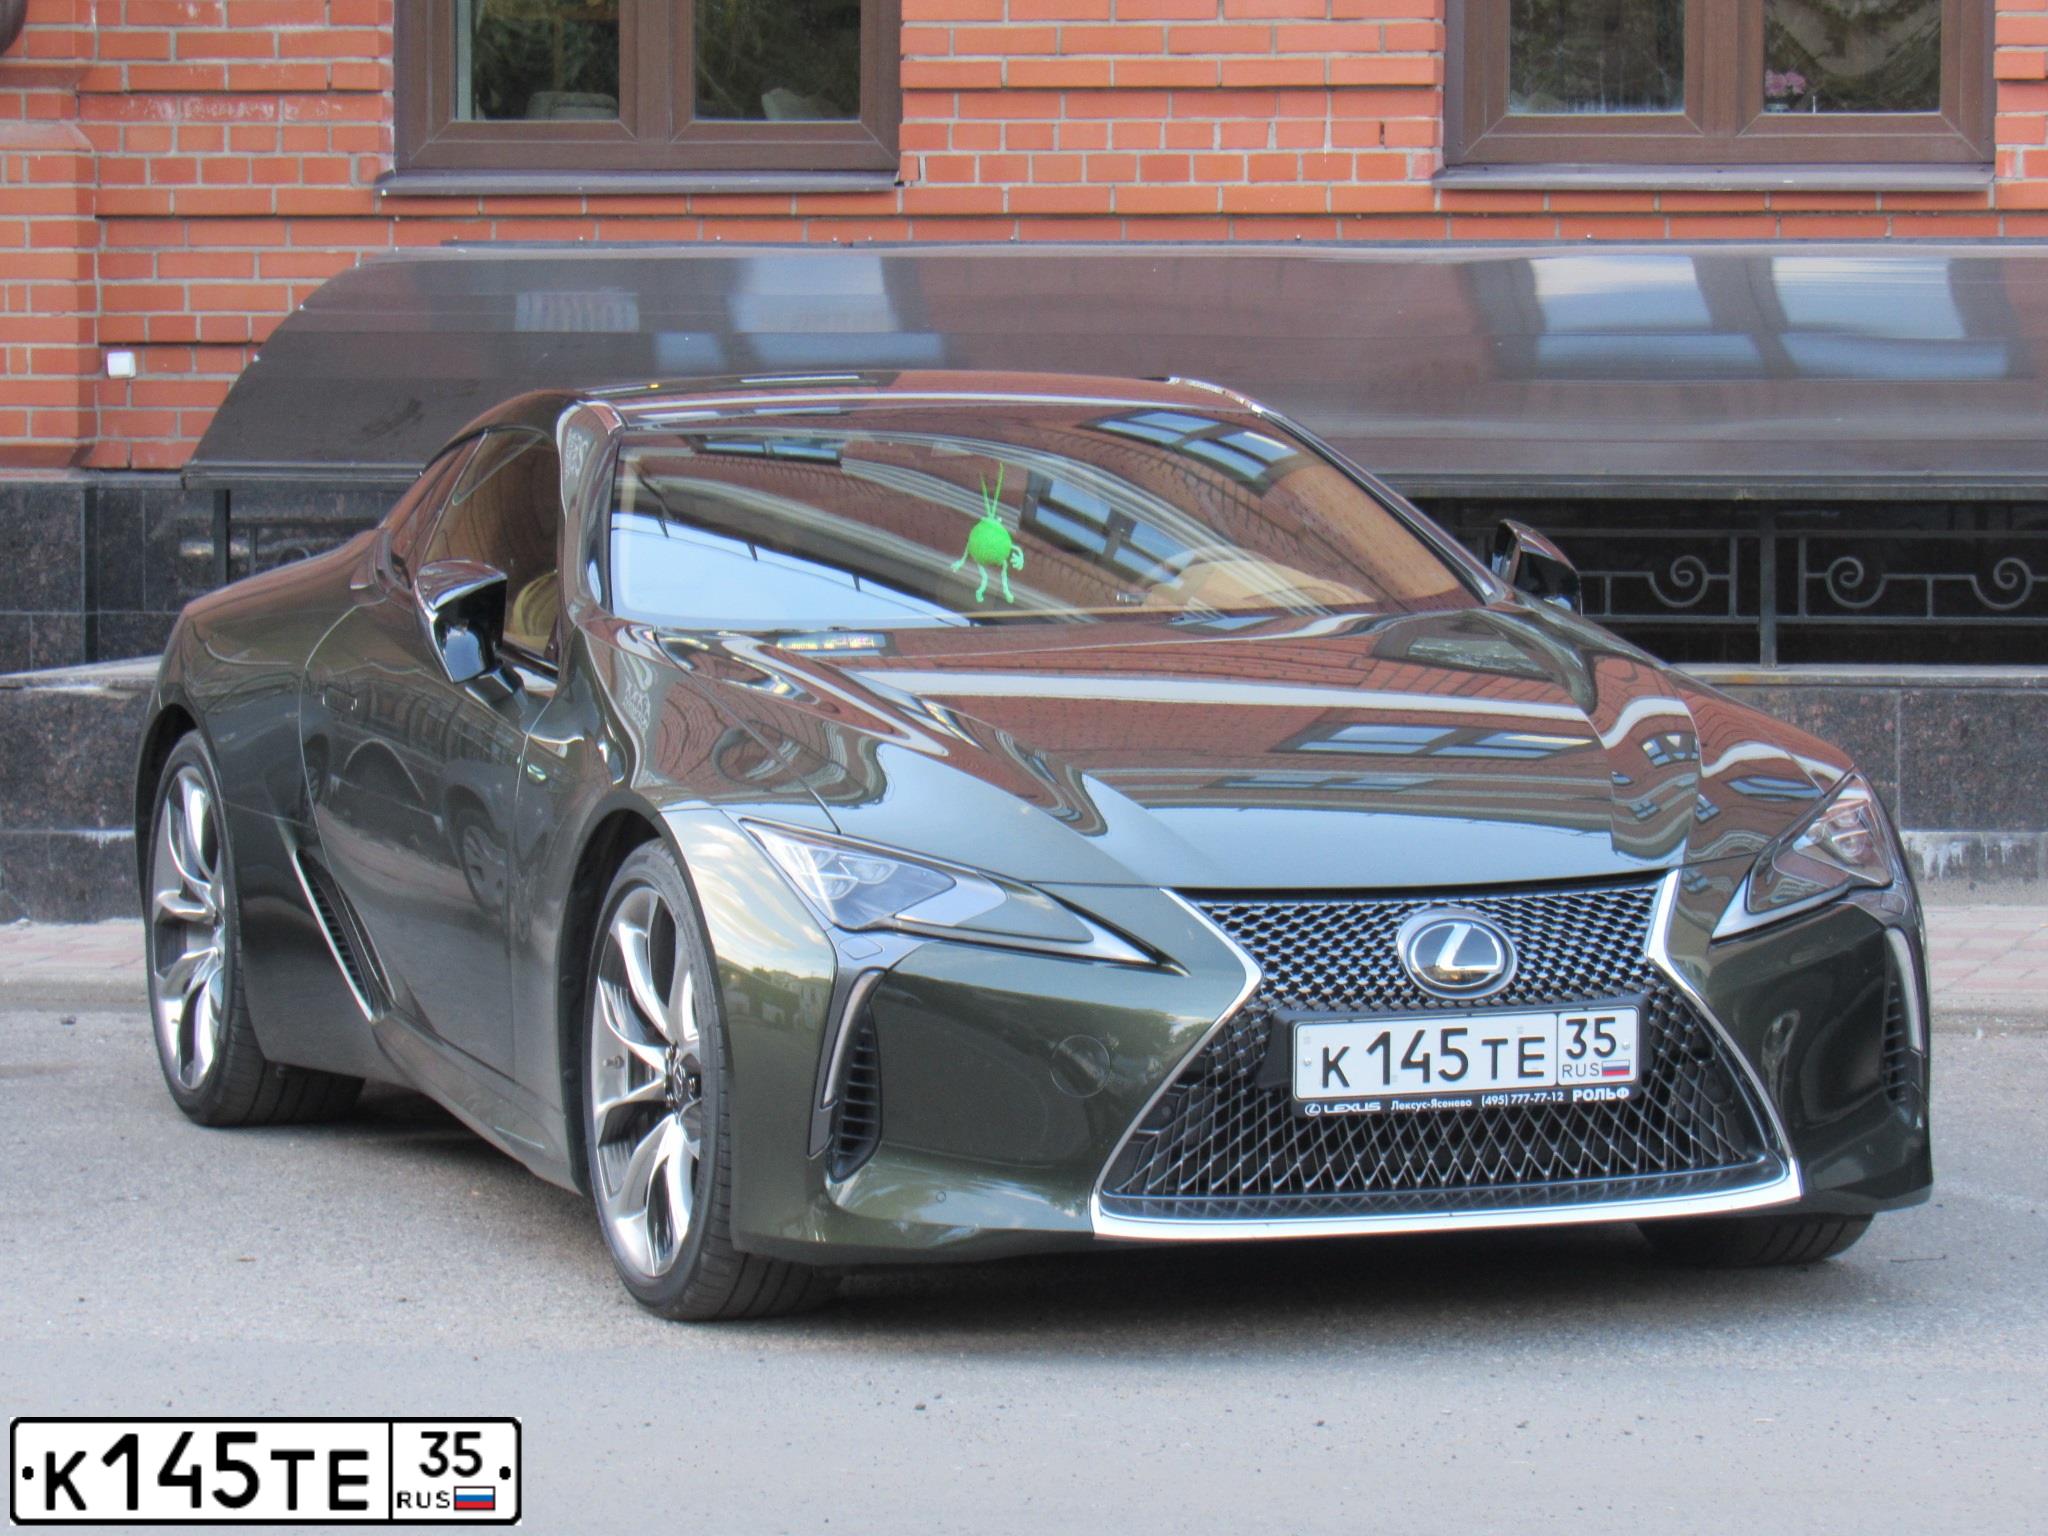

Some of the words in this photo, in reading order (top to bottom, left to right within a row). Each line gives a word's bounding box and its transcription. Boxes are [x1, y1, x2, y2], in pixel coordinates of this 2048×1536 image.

[1565, 1016, 1617, 1060] 35
[1562, 1062, 1601, 1078] RUS
[1481, 1094, 1508, 1107] (495)
[1511, 1091, 1564, 1104] 777-77-12
[1572, 1086, 1630, 1102] РОЛЬФ
[1323, 1101, 1381, 1114] LEXUS
